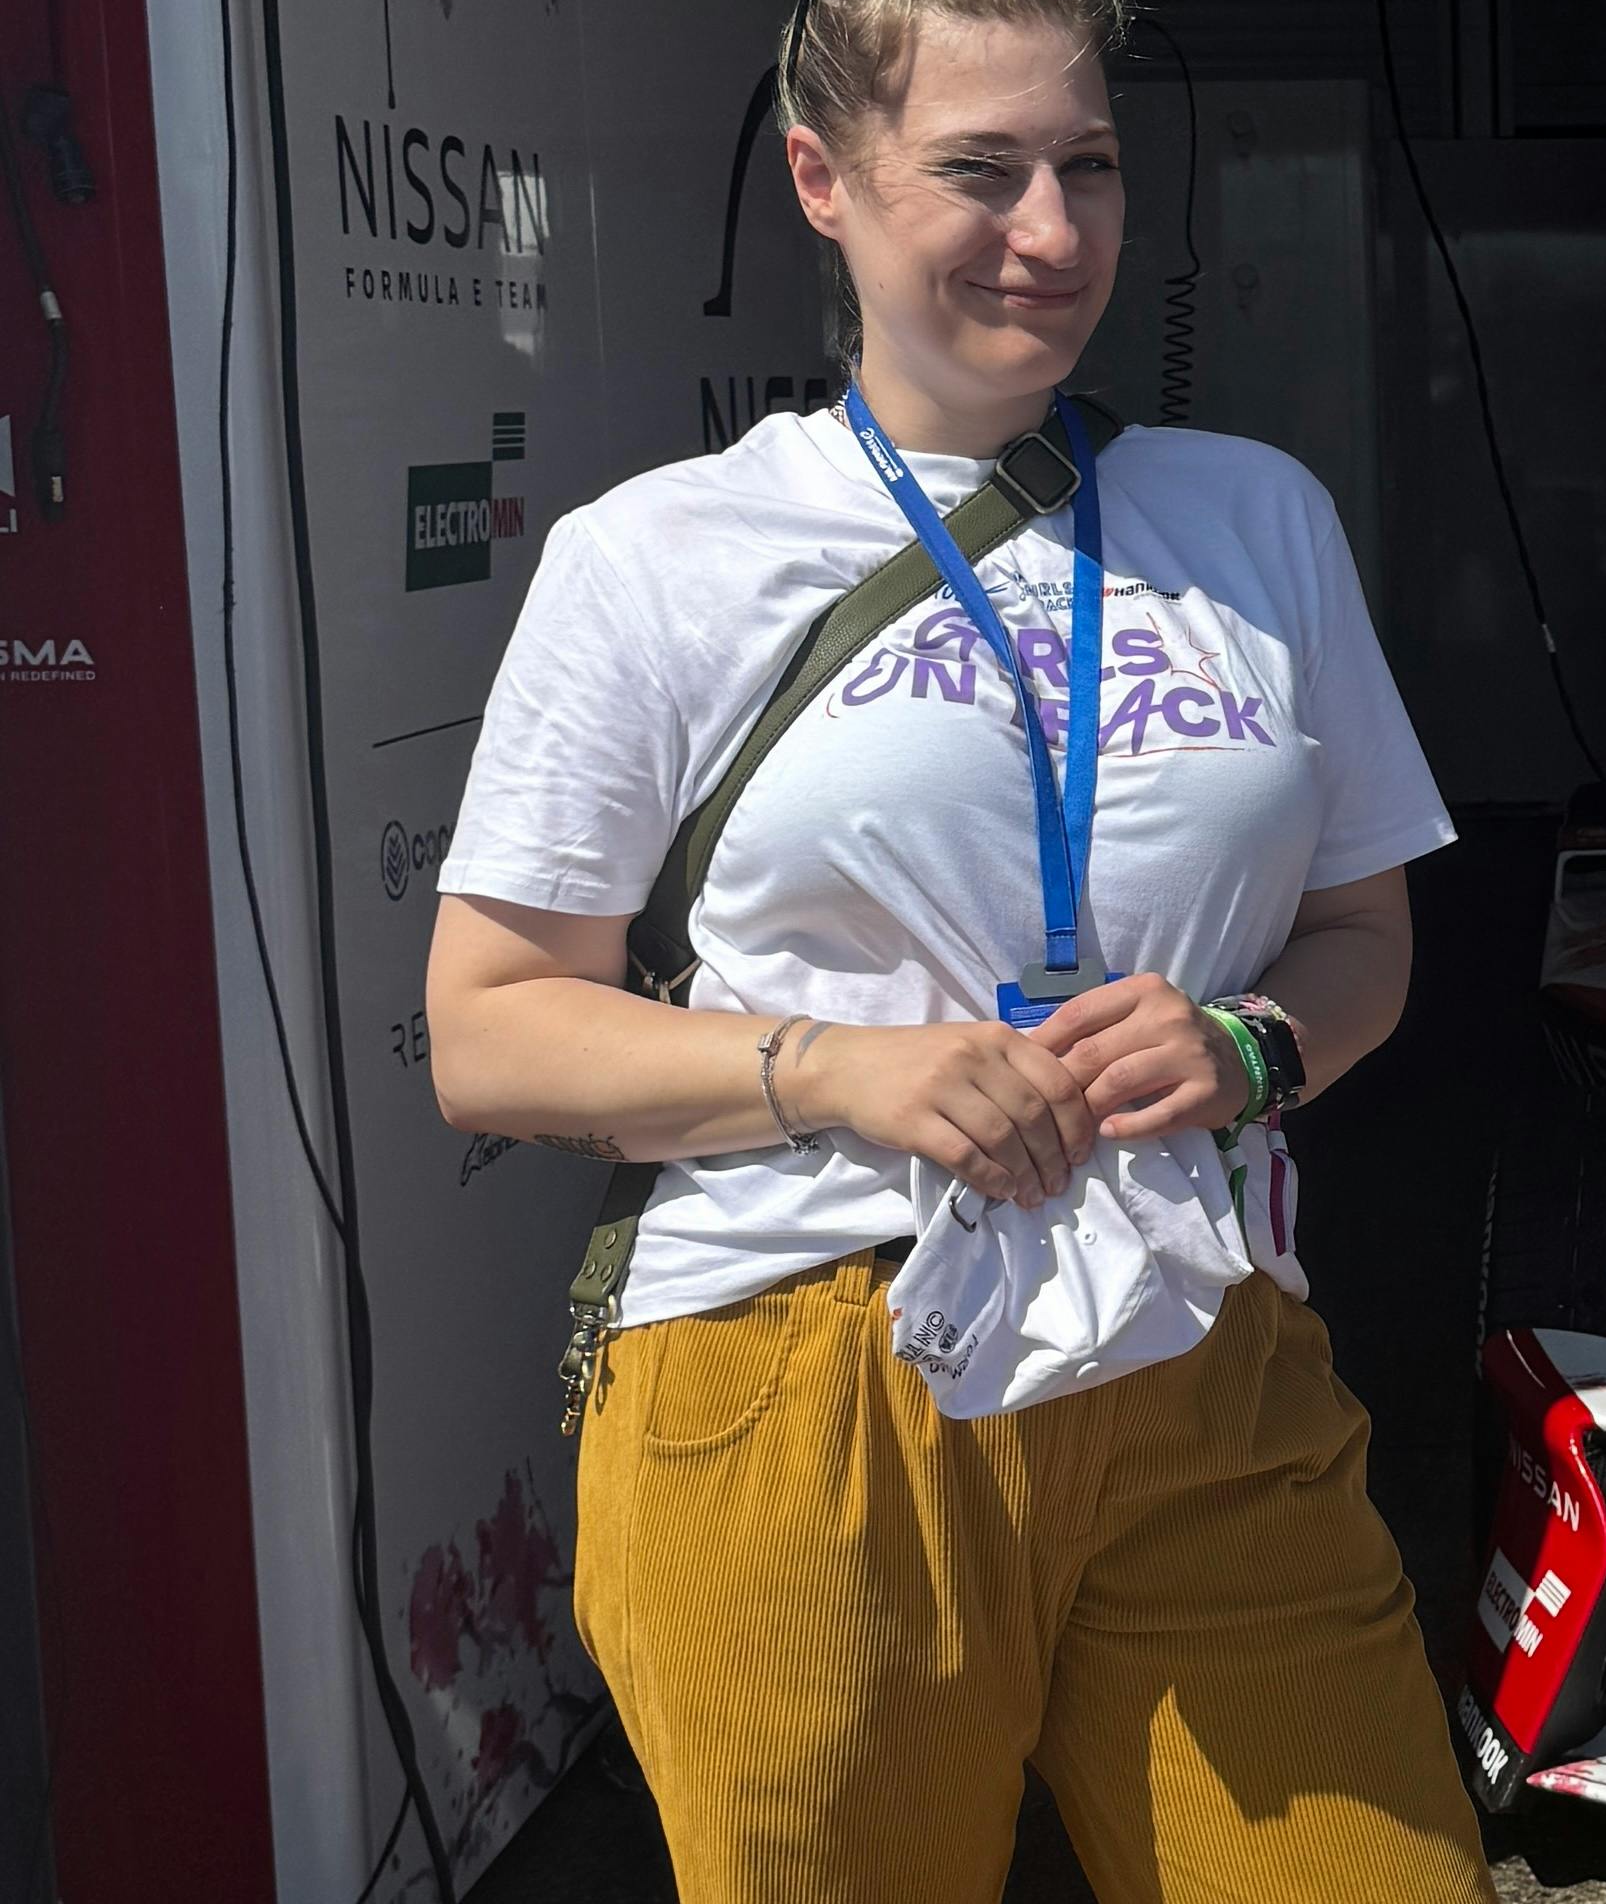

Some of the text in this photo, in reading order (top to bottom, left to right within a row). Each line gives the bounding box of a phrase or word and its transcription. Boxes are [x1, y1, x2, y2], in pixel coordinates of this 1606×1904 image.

[335, 114, 545, 257] NISSAN
[345, 267, 548, 312] FORMULA E TEAM
[414, 496, 525, 550] ELECTROMIN
[10, 670, 97, 682] REDEFINED
[1508, 1432, 1581, 1533] NISSAN
[1484, 1570, 1544, 1659] ELECTROMIN
